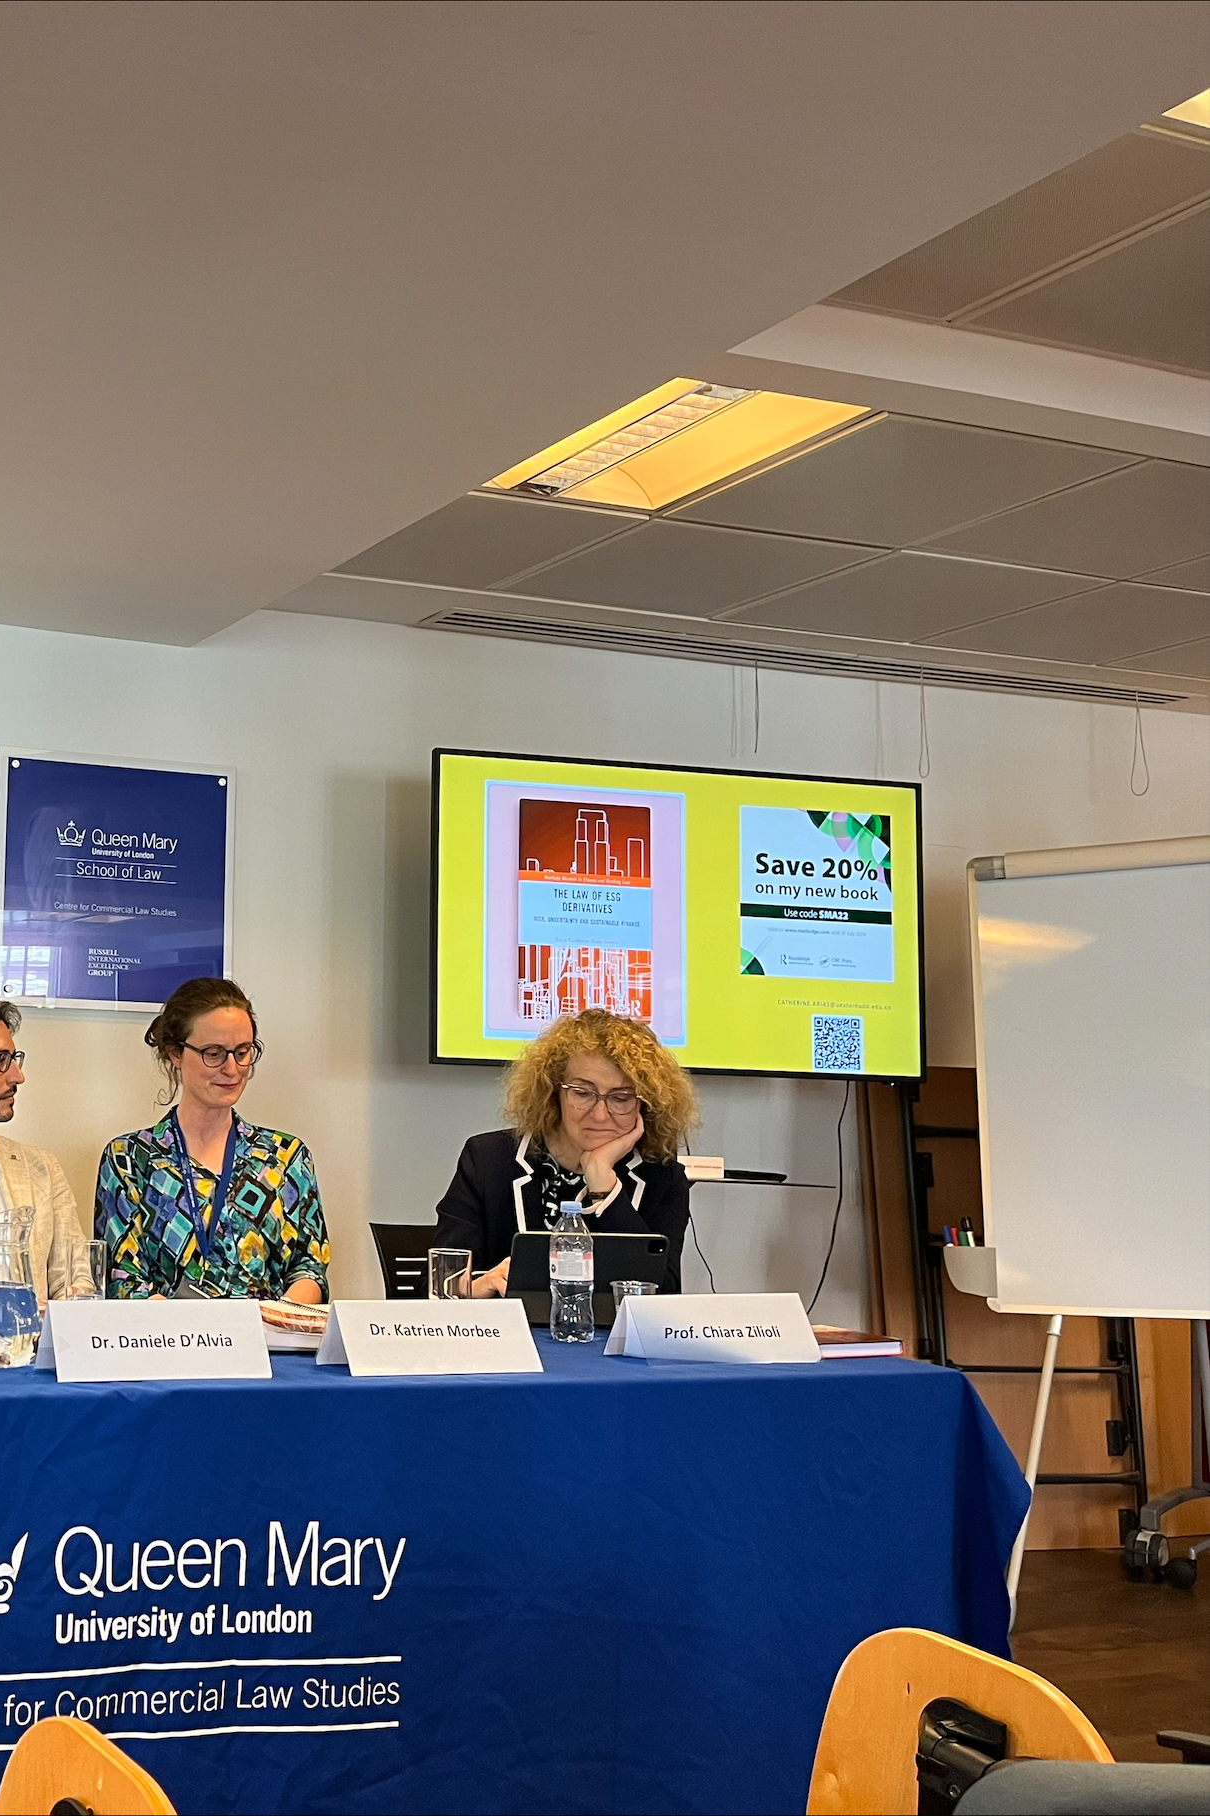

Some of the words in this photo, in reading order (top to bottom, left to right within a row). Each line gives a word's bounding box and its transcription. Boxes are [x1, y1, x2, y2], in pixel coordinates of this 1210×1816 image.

[91, 828, 139, 849] Queen
[142, 832, 178, 854] Mary
[91, 847, 123, 859] University
[123, 849, 132, 858] of
[132, 850, 154, 860] London
[76, 861, 118, 878] School
[121, 864, 134, 878] of
[137, 866, 161, 880] Law
[755, 853, 815, 877] Save
[822, 858, 878, 881] 20%
[554, 889, 568, 899] THE
[572, 890, 588, 900] LAW
[592, 891, 602, 900] OF
[606, 892, 621, 902] ESG
[755, 883, 774, 894] on
[779, 884, 801, 899] my
[805, 886, 836, 898] new
[840, 885, 878, 900] book
[54, 901, 78, 911] Centre
[79, 902, 89, 911] for
[91, 903, 133, 914] Commercial
[135, 906, 149, 915] Law
[151, 907, 177, 917] Studies
[562, 902, 613, 914] DERIVATIVES
[783, 908, 798, 918] Use
[799, 909, 818, 919] code
[818, 910, 849, 920] SMA22
[88, 948, 119, 956] RUSSELL
[88, 955, 142, 964] INTERNATIONAL
[87, 969, 113, 977] GROUP
[88, 962, 129, 970] EXCELLENCE
[369, 1323, 391, 1336] Dr.
[394, 1323, 444, 1337] Katrien
[447, 1324, 501, 1338] Morbee
[664, 1326, 699, 1339] Prof.
[702, 1325, 744, 1338] Chiara
[745, 1325, 781, 1338] Zilioli
[91, 1336, 114, 1349] Dr.
[118, 1334, 176, 1348] Daniele
[180, 1333, 233, 1347] D’Alvia
[54, 1525, 246, 1599] Queen
[267, 1520, 406, 1601] Mary
[55, 1605, 183, 1644] University
[189, 1604, 216, 1636] of
[221, 1604, 313, 1635] London
[3, 1693, 46, 1727] for
[54, 1680, 226, 1721] Commercial
[236, 1678, 293, 1710] Law
[303, 1676, 401, 1709] Studies
